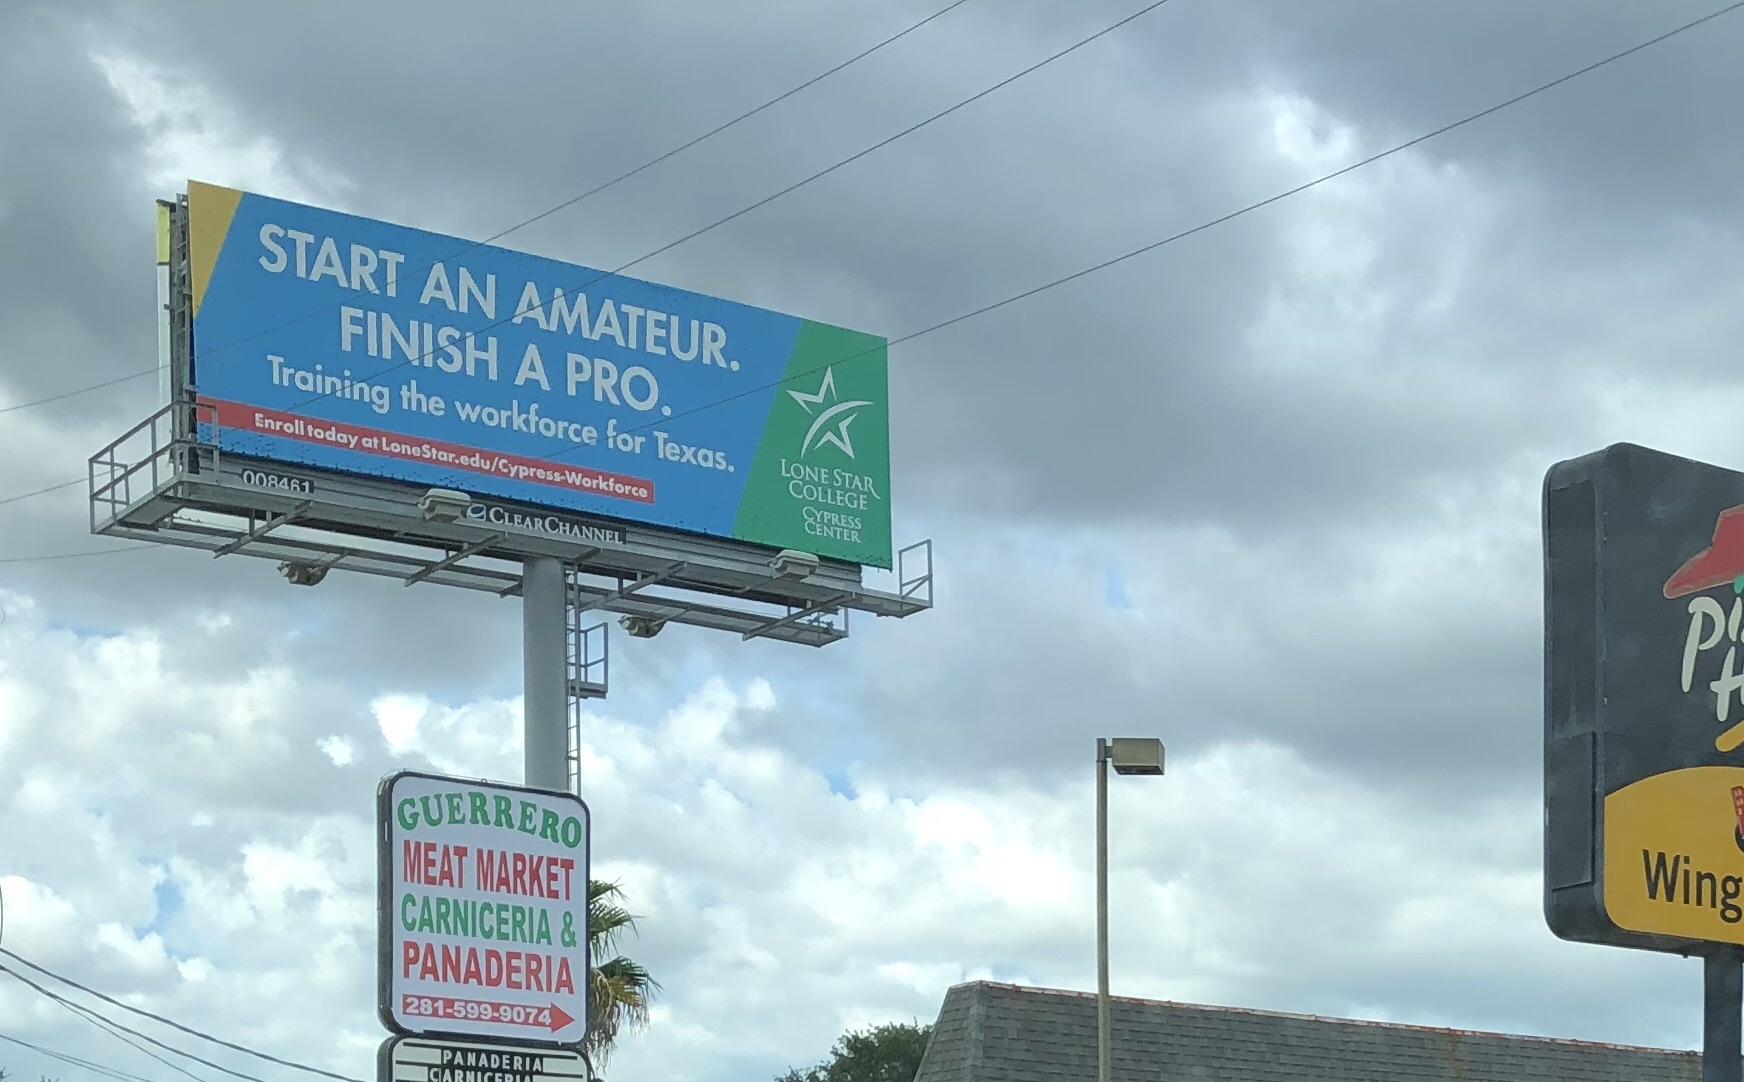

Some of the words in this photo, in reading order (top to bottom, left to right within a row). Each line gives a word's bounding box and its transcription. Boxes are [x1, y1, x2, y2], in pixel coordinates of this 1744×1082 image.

[258, 223, 405, 298] START
[418, 261, 496, 320] AN
[511, 281, 740, 372] AMATEUR.
[340, 305, 498, 381] FINISH
[513, 343, 551, 392] A
[566, 352, 673, 416] PRO.
[266, 354, 390, 415] Training
[399, 379, 446, 416] the
[454, 399, 598, 446] workforce
[606, 418, 646, 454] for
[653, 430, 735, 473] Texas.
[243, 470, 310, 493] 008461
[254, 412, 305, 436] Enroll
[306, 426, 359, 449] today
[361, 436, 379, 449] at
[381, 436, 649, 499] LoneStar.edu/Cypress-Workforce
[780, 458, 829, 485] LONE
[833, 468, 881, 500] STAR
[788, 479, 868, 511] COLLEGE
[802, 505, 862, 530] CYPRESS
[804, 520, 862, 544] CENTER
[397, 791, 582, 849] GUERRERO
[402, 839, 468, 889] MEAT
[476, 848, 575, 901] MARKET
[401, 893, 553, 946] CARNICERIA
[560, 910, 577, 948] &
[402, 940, 575, 995] PANADERIA
[405, 996, 552, 1025] 281-599-9074
[442, 1049, 543, 1072] PANADERIA
